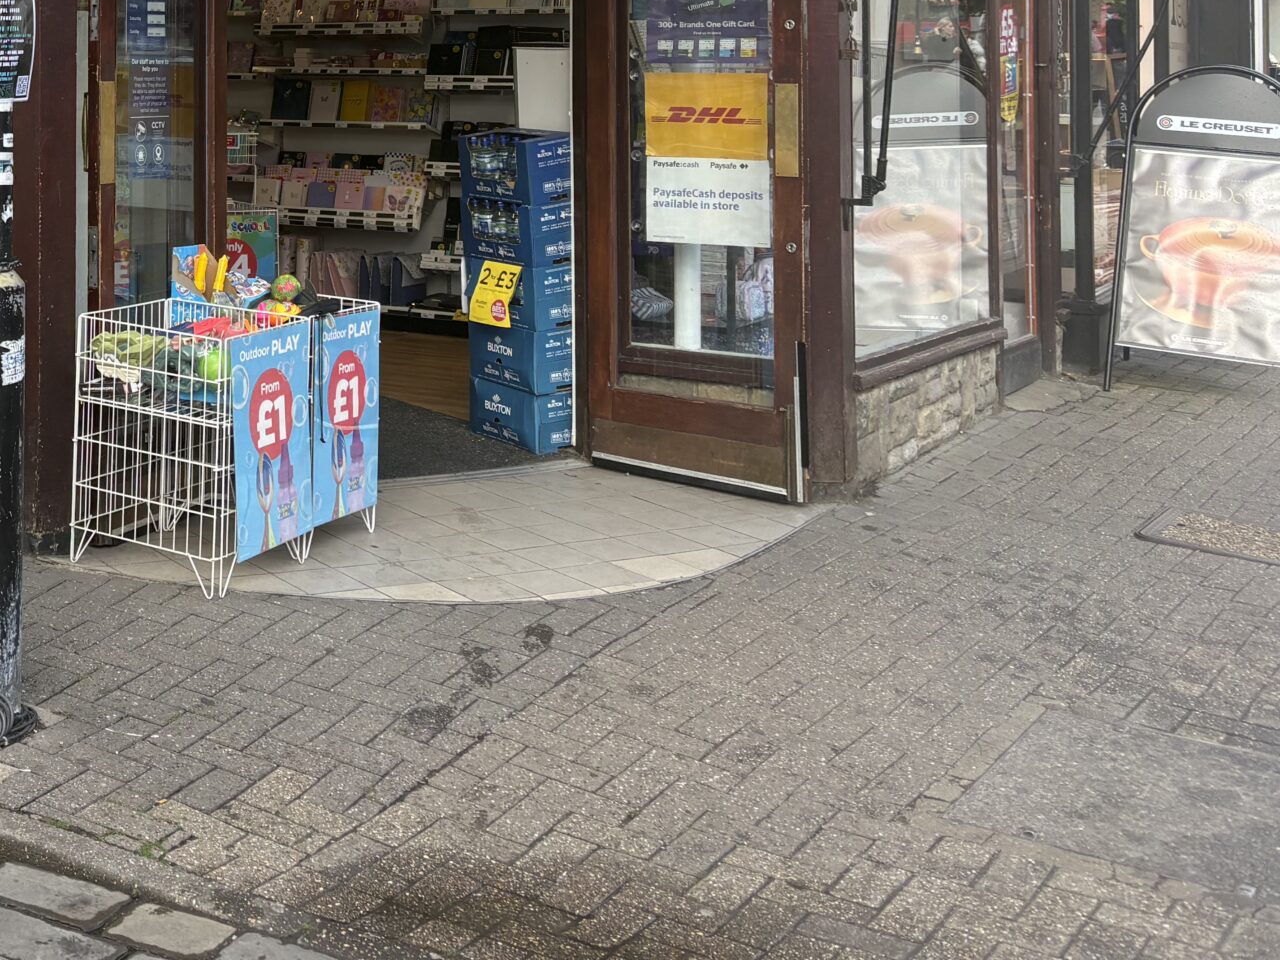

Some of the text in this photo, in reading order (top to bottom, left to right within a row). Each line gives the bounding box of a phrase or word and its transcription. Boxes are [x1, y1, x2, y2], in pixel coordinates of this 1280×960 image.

[687, 0, 714, 12] Ultimate
[657, 21, 678, 29] 300+
[722, 20, 737, 28] Gift
[667, 106, 746, 125] DHL
[151, 121, 166, 129] CCTV
[1180, 120, 1273, 134] LE CREUSET
[653, 160, 700, 169] Paysafe:cash
[710, 161, 737, 170] Paysafe
[652, 187, 764, 202] PaysafeCash deposits
[652, 198, 740, 211] available in store
[231, 220, 271, 233] SCHOOL
[479, 267, 518, 290] 2 £3
[491, 305, 505, 313] BEST
[323, 320, 372, 343] Outdoor PLAY
[239, 333, 300, 362] Outdoor PLAY
[487, 341, 513, 357] BUXTON
[338, 362, 355, 375] From
[260, 380, 280, 395] From
[333, 375, 359, 424] £1
[484, 399, 512, 416] BUXTON
[256, 394, 287, 449] £1
